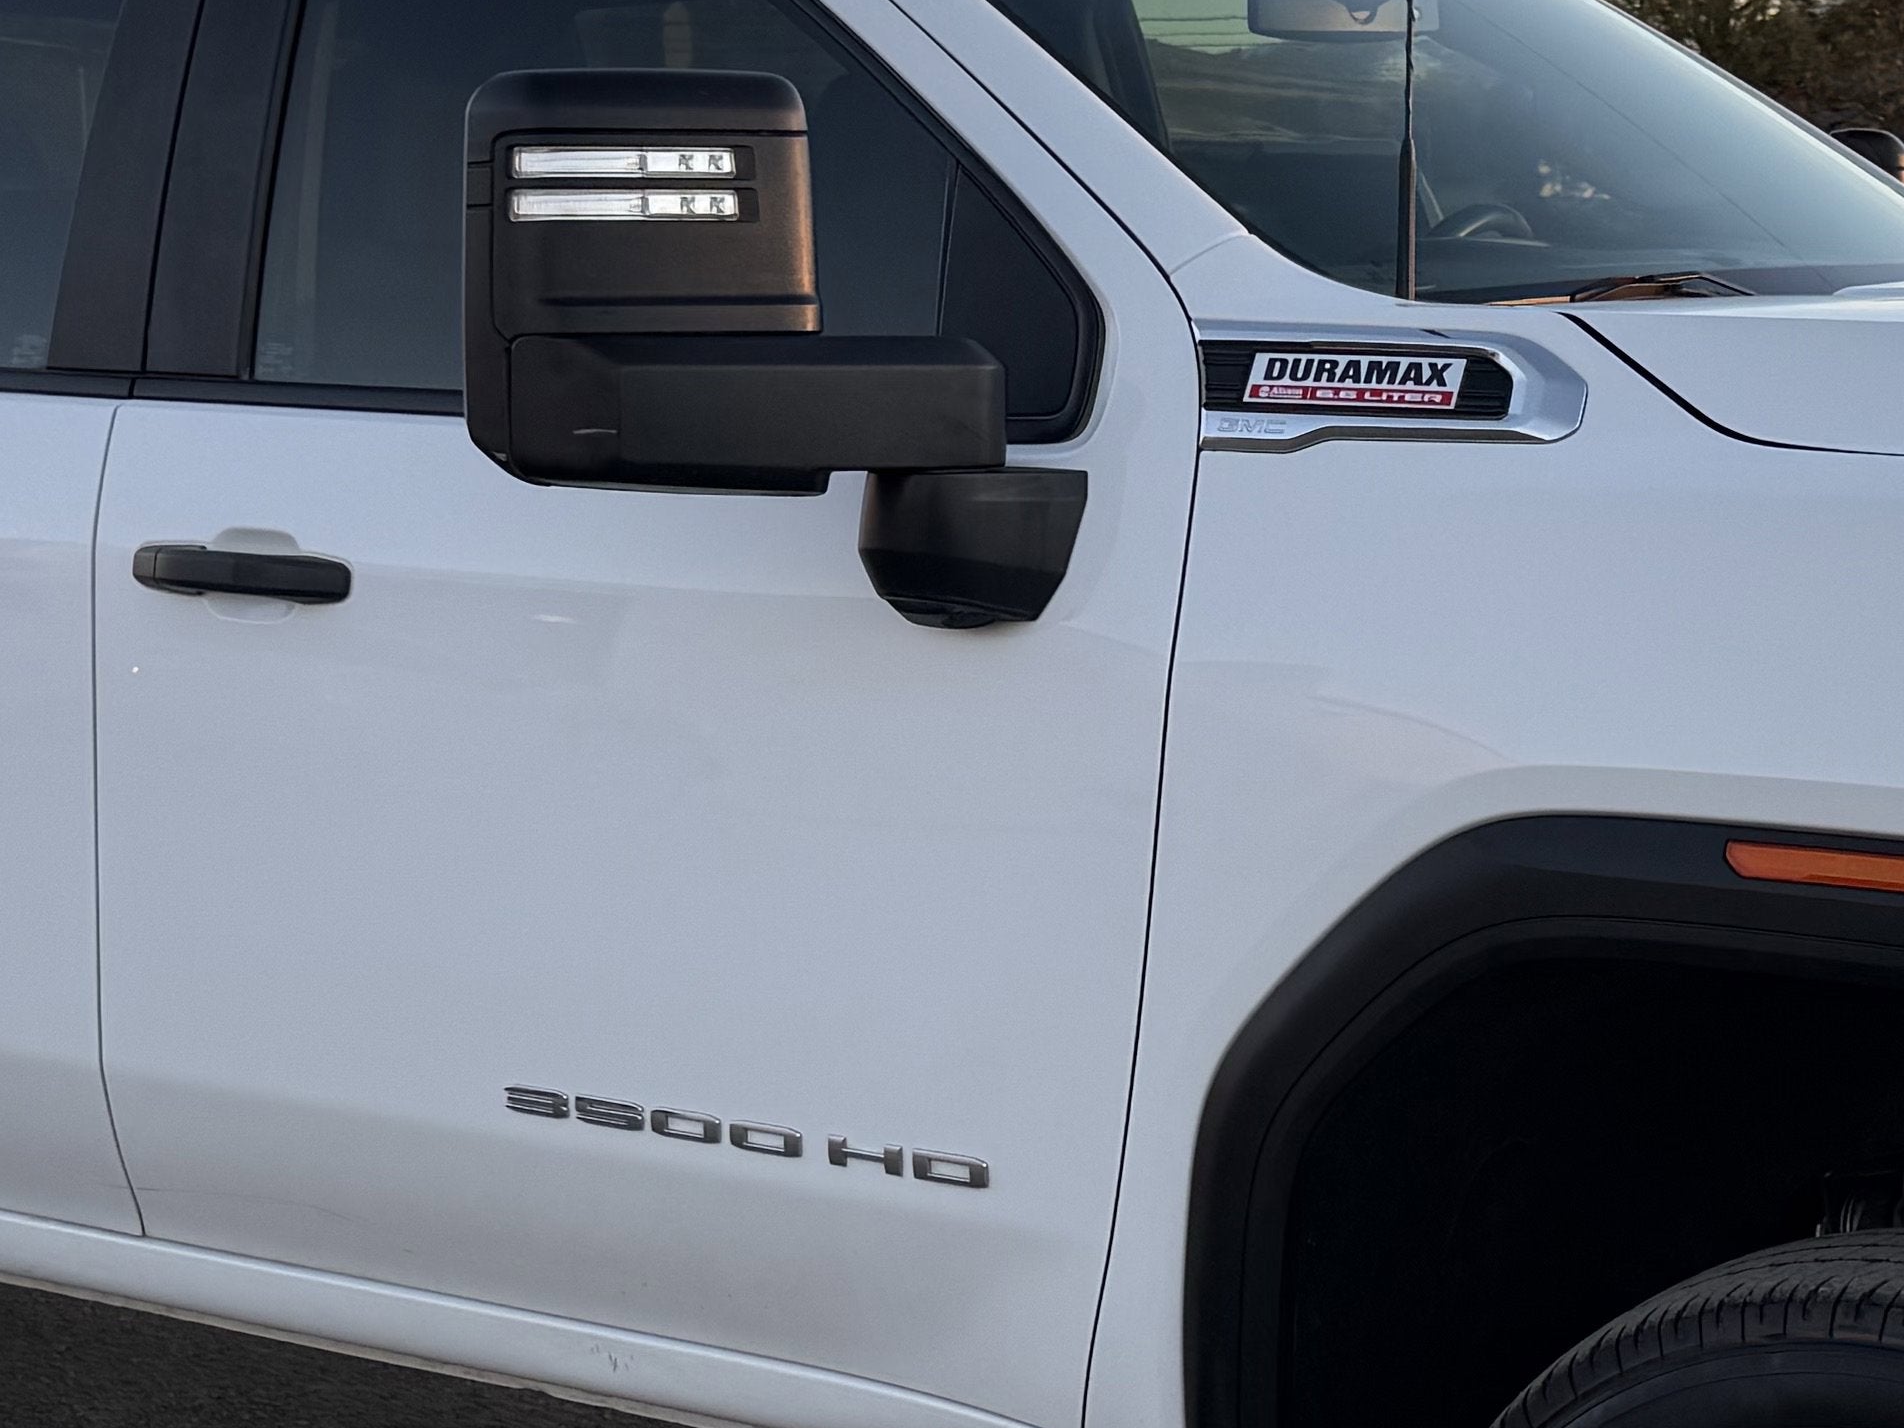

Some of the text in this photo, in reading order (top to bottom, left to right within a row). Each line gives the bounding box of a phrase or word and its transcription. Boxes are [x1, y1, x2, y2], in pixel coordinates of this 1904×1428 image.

[1263, 357, 1453, 387] DURAMAX
[1364, 390, 1443, 404] LITER
[504, 1082, 990, 1189] 3500 HD
